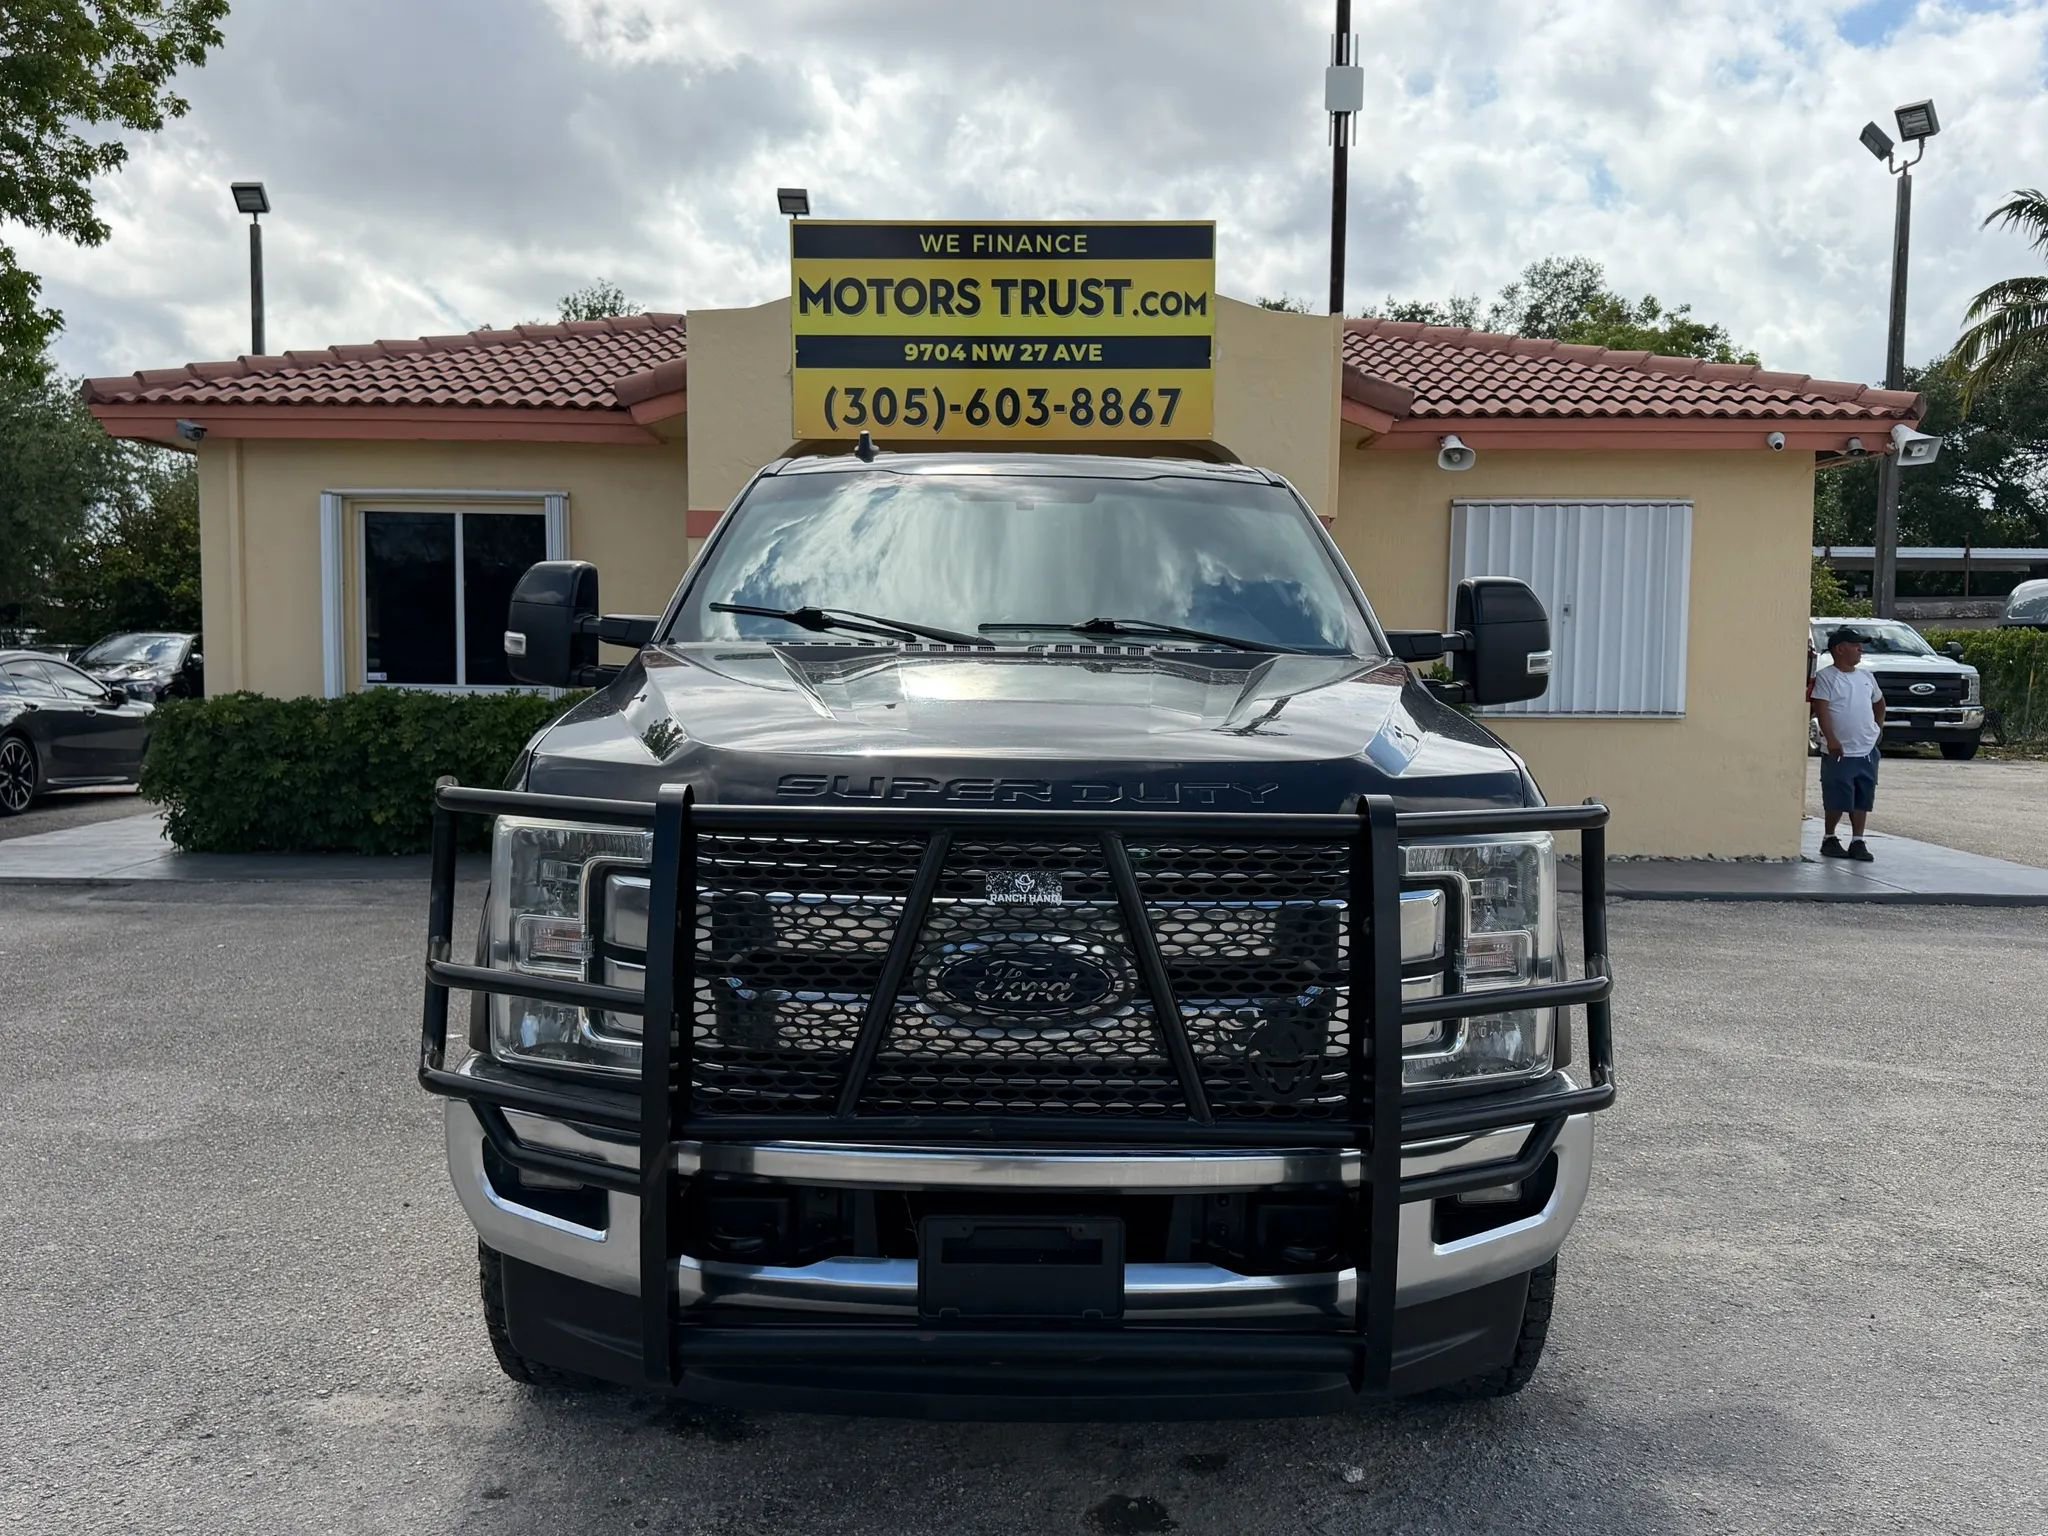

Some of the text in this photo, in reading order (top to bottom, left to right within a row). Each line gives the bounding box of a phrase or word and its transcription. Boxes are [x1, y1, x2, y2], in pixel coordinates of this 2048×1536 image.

[919, 233, 1089, 254] WE FINANCE
[798, 277, 982, 318] MOTORS
[904, 343, 1103, 363] 9704 NW 27 AVE
[823, 385, 1182, 433] (305)-603-8867
[776, 773, 1279, 804] SUPER DUTY
[989, 893, 1061, 904] RANCH HAND
